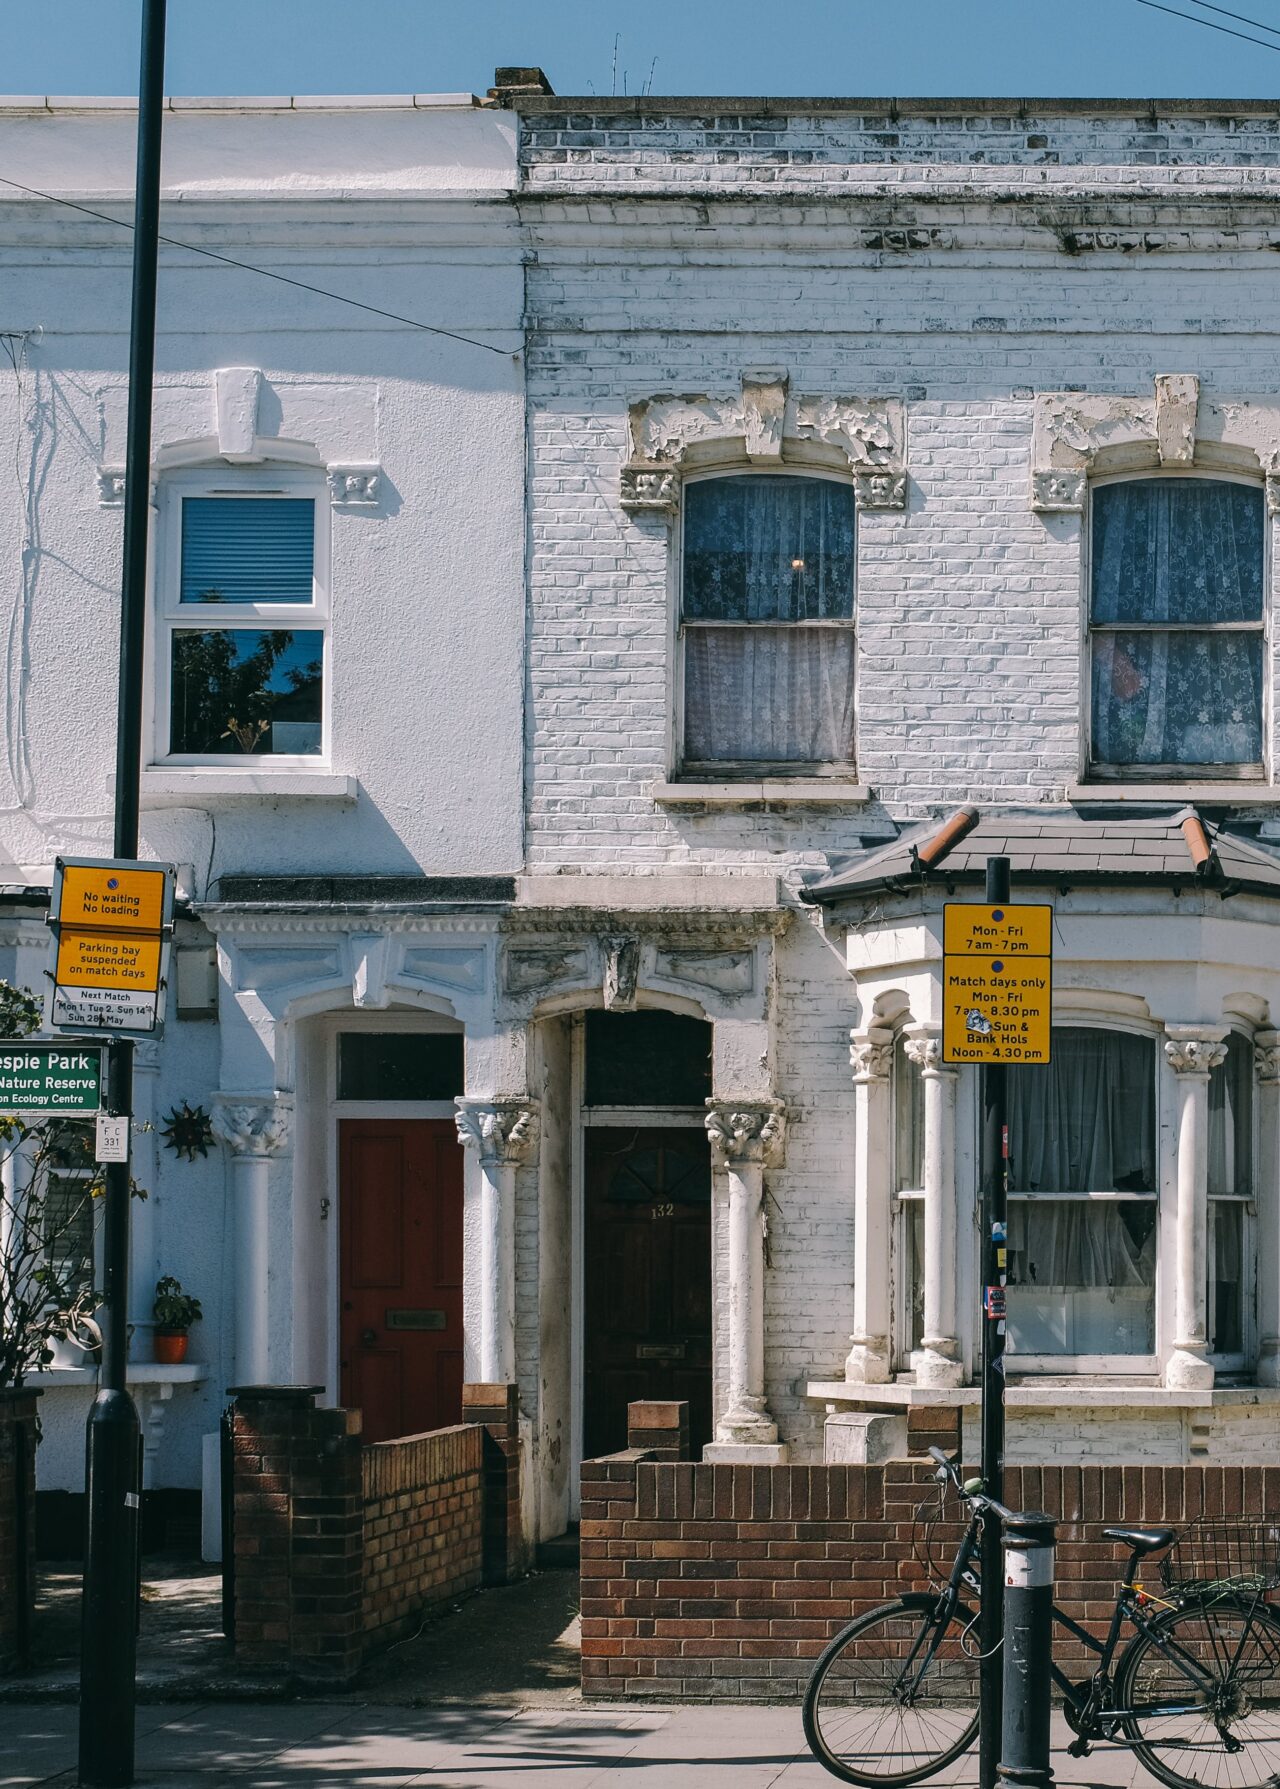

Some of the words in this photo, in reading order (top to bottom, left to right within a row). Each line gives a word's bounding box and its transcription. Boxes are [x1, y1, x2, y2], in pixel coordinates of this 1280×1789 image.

[84, 892, 98, 902] No
[102, 894, 140, 906] waiting
[83, 903, 98, 913] No
[101, 904, 139, 917] loading
[972, 926, 998, 936] Mon
[1008, 926, 1023, 936] Fri
[79, 942, 118, 955] Parking
[122, 945, 140, 956] bay
[81, 955, 136, 966] suspended
[69, 966, 82, 974] on
[86, 966, 118, 976] match
[121, 968, 145, 979] days
[950, 976, 986, 986] Match
[990, 977, 1017, 988] days
[1021, 978, 1046, 989] only
[81, 991, 101, 999] Next
[104, 992, 131, 1001] Match
[972, 992, 998, 1002] Mon
[1008, 993, 1023, 1002] Fri
[58, 1002, 77, 1011] Mon
[88, 1004, 104, 1013] Tue
[117, 1006, 134, 1014] Sun
[991, 1007, 1019, 1016] 8.30
[1022, 1009, 1039, 1018] pm
[68, 1014, 85, 1022] Sun
[106, 1015, 124, 1025] May
[993, 1022, 1016, 1032] Sun
[1021, 1023, 1029, 1032] &
[967, 1034, 996, 1044] Bank
[1002, 1034, 1028, 1044] Hols
[952, 1048, 983, 1057] Noon
[992, 1048, 1021, 1058] 4.30
[1025, 1050, 1042, 1059] pm
[0, 1052, 40, 1072] spie
[48, 1053, 89, 1069] Park
[45, 1077, 96, 1089] Reserve
[12, 1094, 49, 1105] Ecology
[52, 1094, 84, 1103] Centre
[104, 1137, 119, 1146] 331
[651, 1203, 674, 1220] 132
